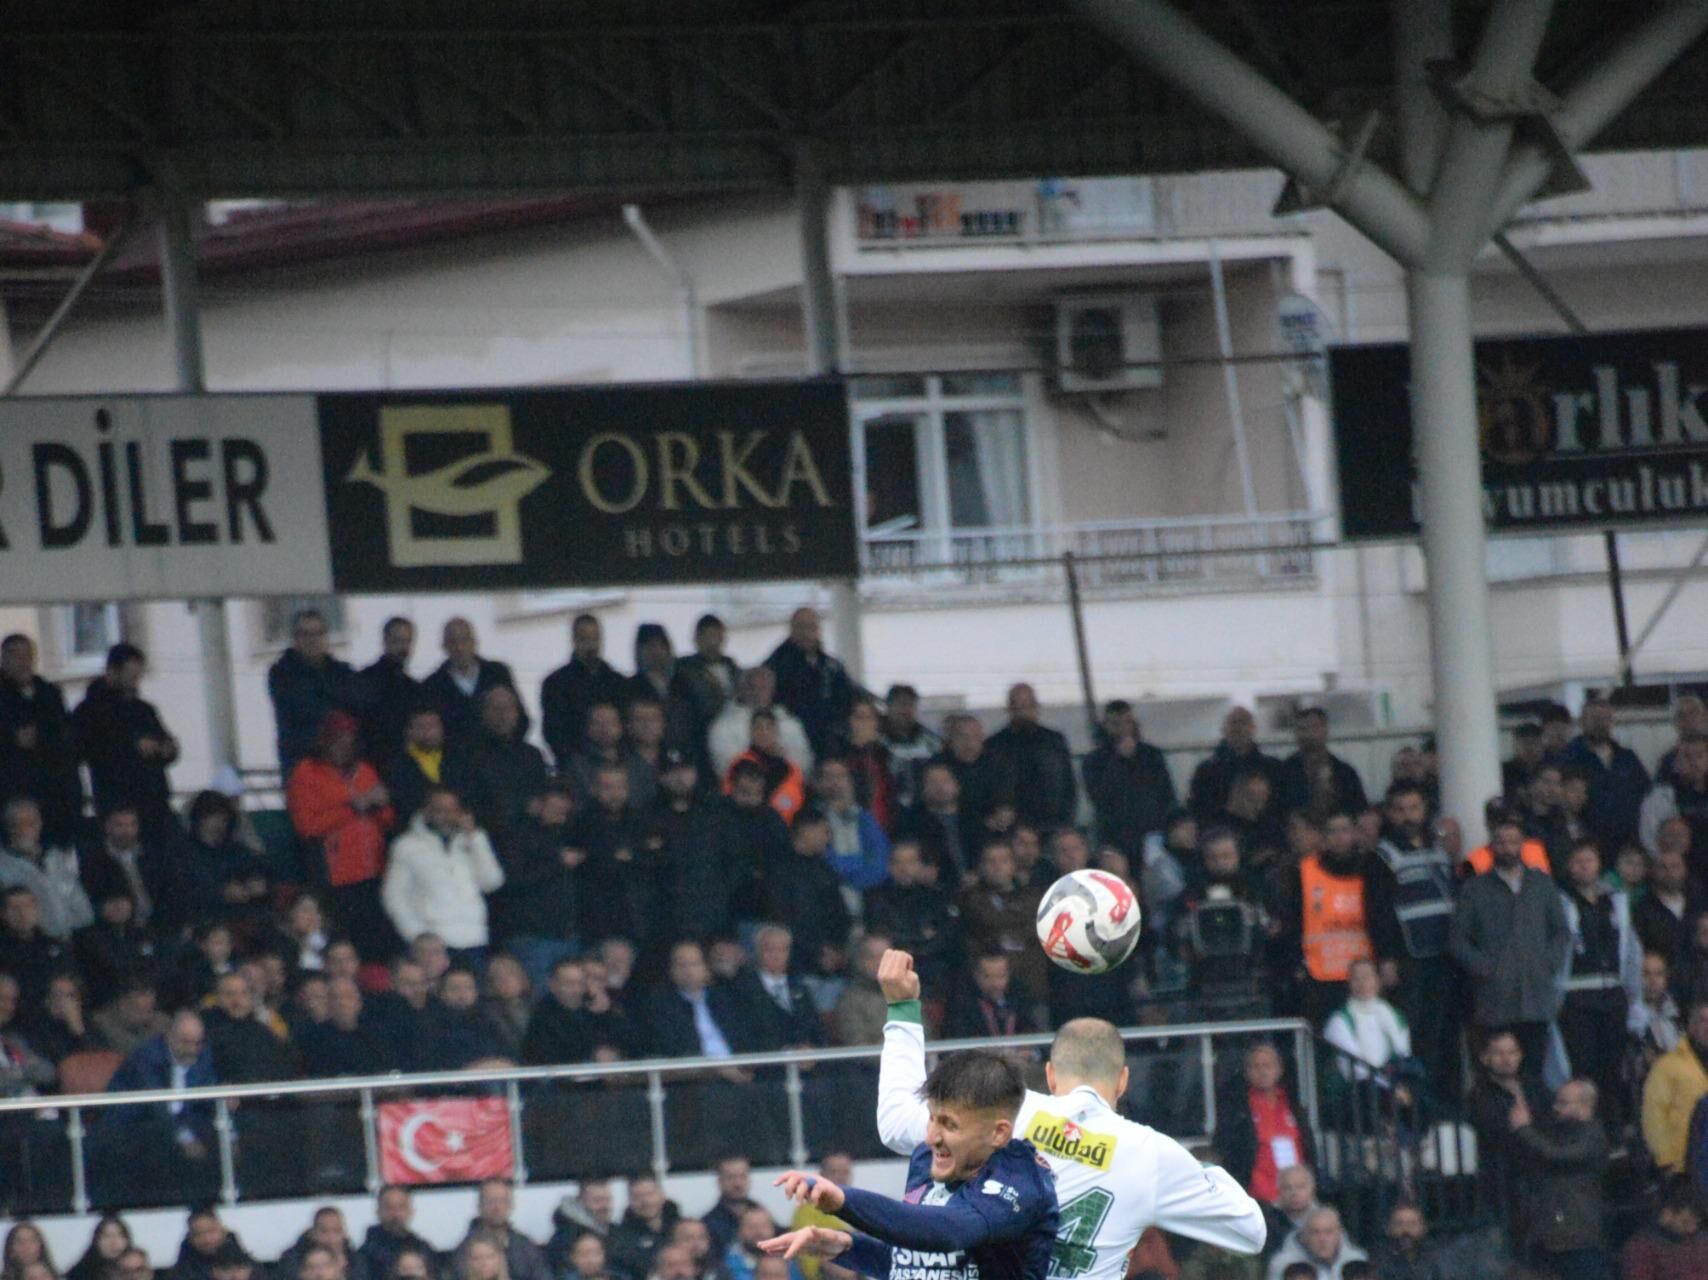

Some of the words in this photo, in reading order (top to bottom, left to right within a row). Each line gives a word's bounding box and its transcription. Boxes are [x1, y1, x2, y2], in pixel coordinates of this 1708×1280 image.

[32, 407, 276, 547] DİLER
[578, 429, 834, 513] ORKA
[623, 524, 801, 557] HOTELS
